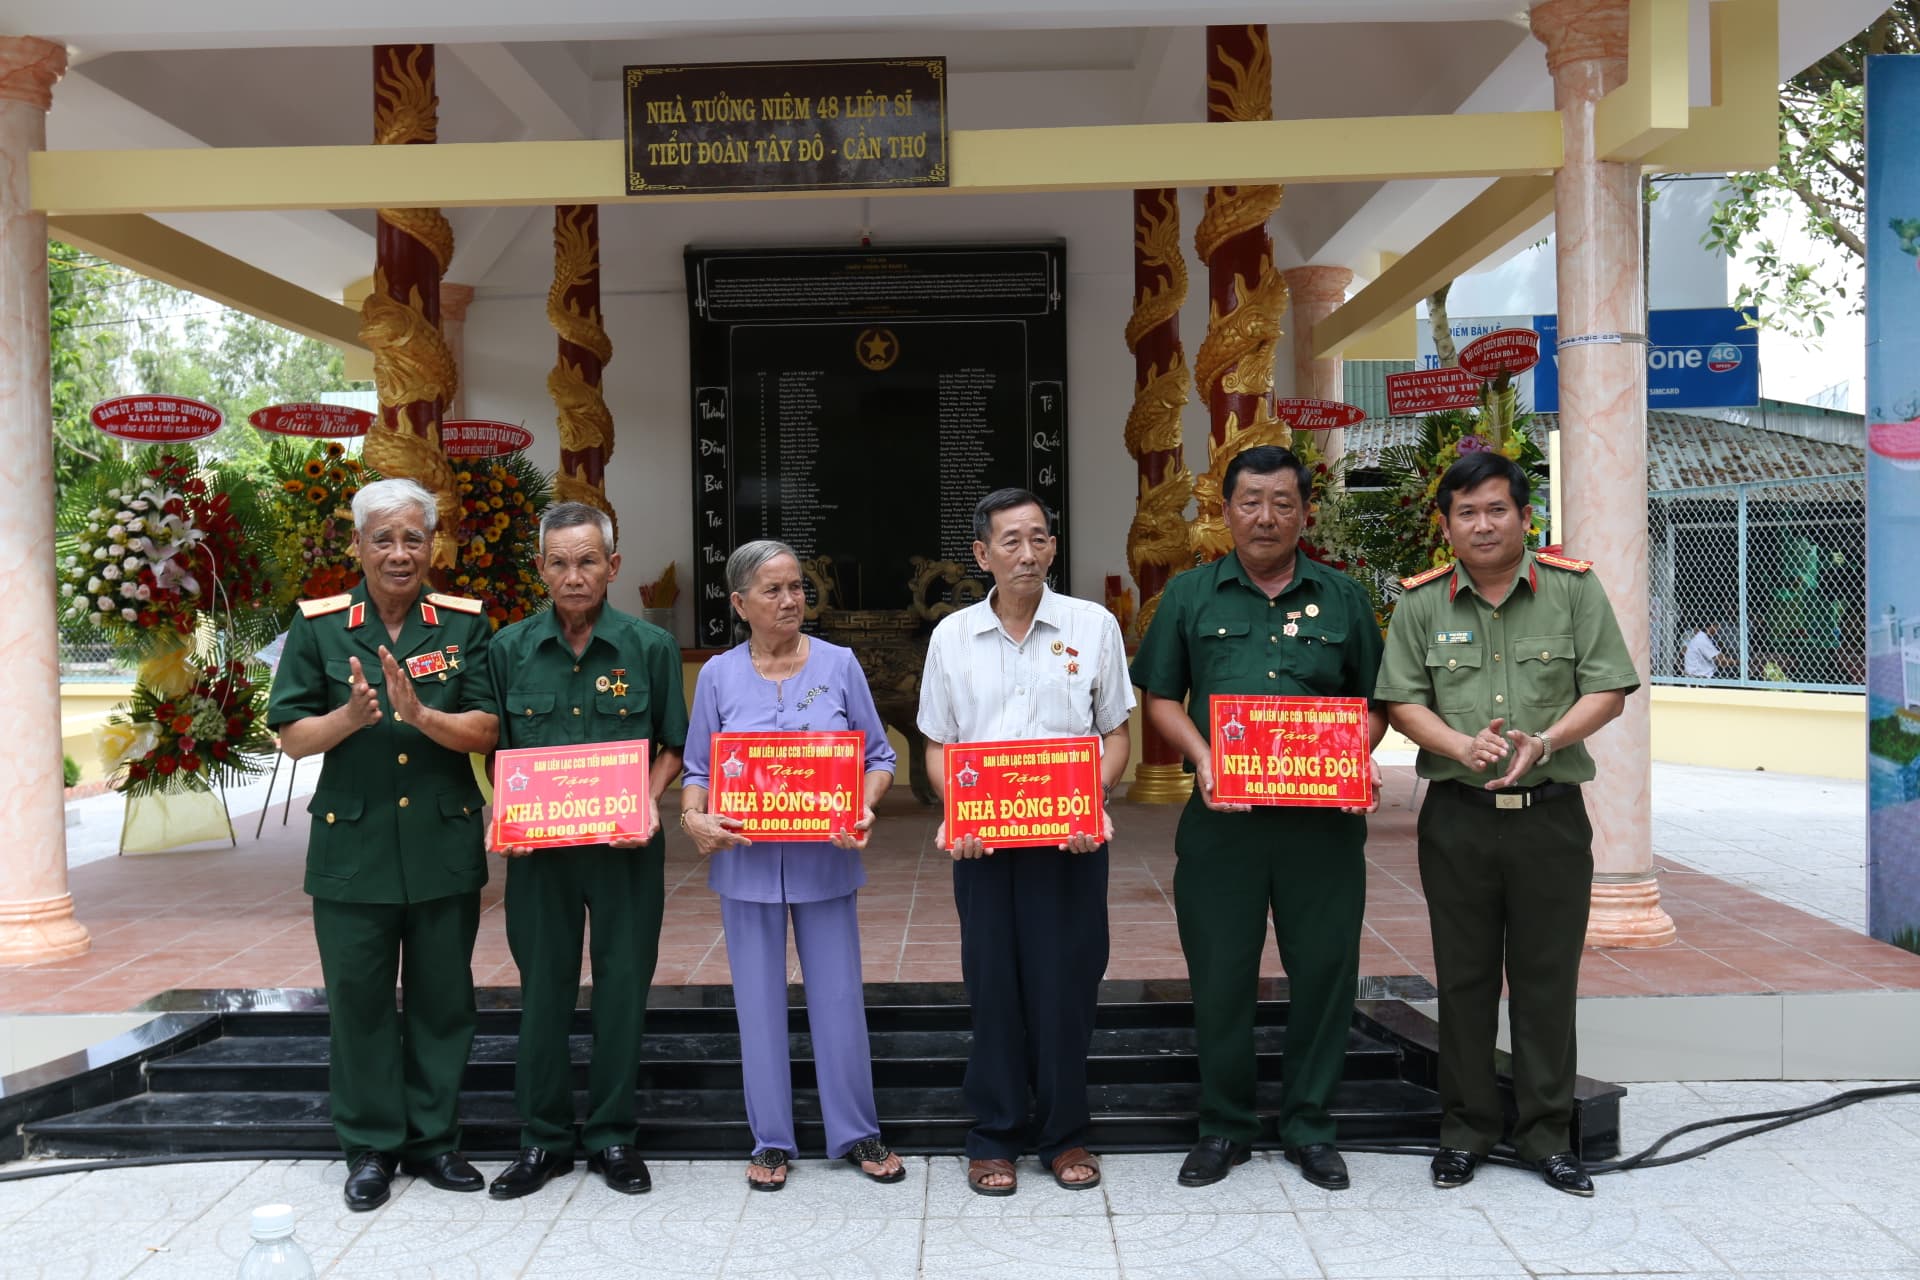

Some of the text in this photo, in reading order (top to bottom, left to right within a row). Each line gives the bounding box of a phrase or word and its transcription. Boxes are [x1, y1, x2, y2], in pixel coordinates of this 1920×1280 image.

[647, 94, 687, 124] NHÀ
[692, 91, 756, 123] TƯỞNG
[762, 92, 810, 126] NIỆM
[817, 96, 839, 119] 48
[845, 90, 888, 125] LIỆT
[648, 130, 691, 166] TIỂU
[697, 136, 749, 165] ĐOÀN
[755, 135, 793, 163] TÂY
[799, 133, 824, 162] ĐÔ
[843, 125, 881, 160] CẦN
[888, 132, 927, 159] THƠ
[1711, 347, 1736, 361] 4G
[276, 415, 360, 434] Chúc Mừng
[704, 474, 723, 492] Bia
[1250, 709, 1263, 722] BAN
[1264, 709, 1276, 722] LIÊN
[1269, 729, 1320, 744] Tặng
[748, 743, 854, 761] BAN LIÊN LẠC CCB TIỂU ĐOÀN TÂY ĐÔ
[983, 748, 1090, 768] BAN LIÊN LẠC CCB TIỂU ĐOÀN TÂY ĐÔ
[534, 759, 546, 772] BAN
[547, 756, 560, 771] LIÊN
[561, 757, 573, 772] LẠC
[587, 752, 600, 768] TIỂU
[601, 754, 617, 767] ĐOÀN
[618, 753, 629, 766] TÂY
[1224, 747, 1359, 783] NHÀ ĐỒNG ĐỘI
[767, 764, 817, 779] Tặng
[1002, 772, 1052, 786] Tặng
[552, 775, 600, 788] Tặng
[1246, 782, 1338, 796] 40.000.000đ
[505, 788, 638, 824] NHÀ ĐỒNG ĐỘI
[720, 782, 852, 818] NHÀ ĐỒNG ĐỘI
[957, 788, 1090, 821] NHÀ ĐỒNG ĐỘI
[525, 821, 616, 839] 40.000.000đ
[978, 822, 1070, 838] 40.000.000đ
